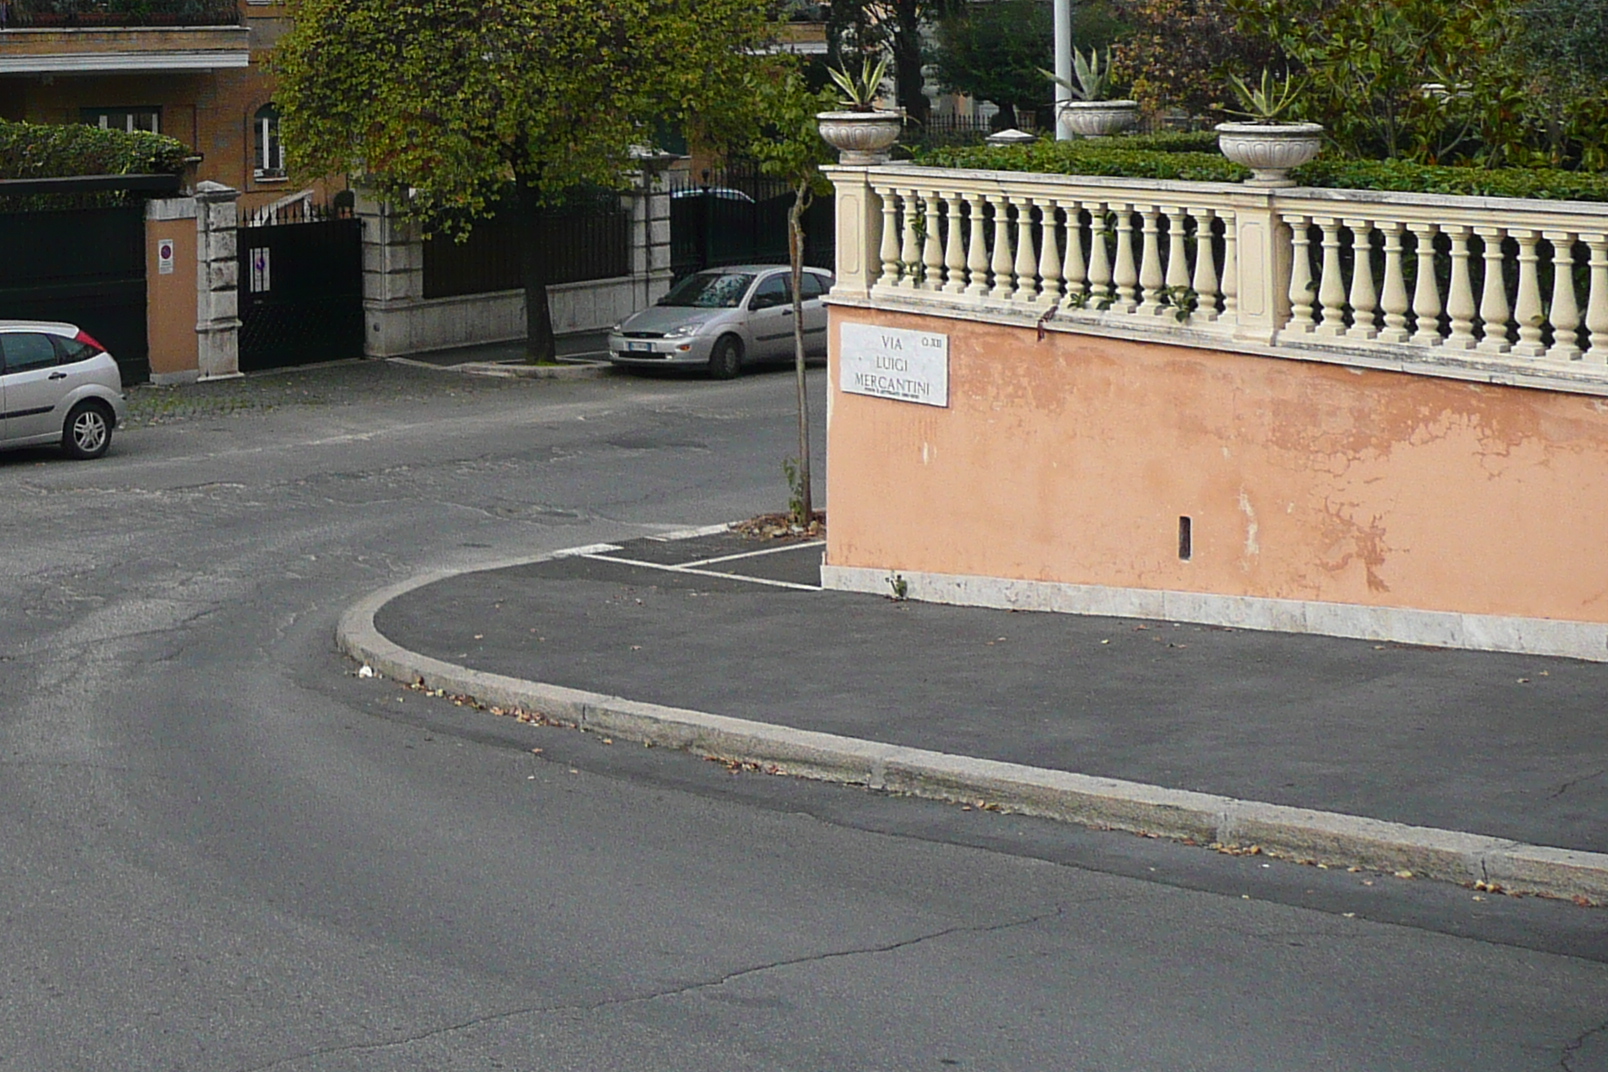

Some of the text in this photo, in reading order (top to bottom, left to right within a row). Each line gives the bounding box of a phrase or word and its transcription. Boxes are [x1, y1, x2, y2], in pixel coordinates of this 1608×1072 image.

[881, 335, 903, 350] VIA
[876, 355, 908, 372] LUIGI
[855, 372, 930, 396] MERCANTINI
